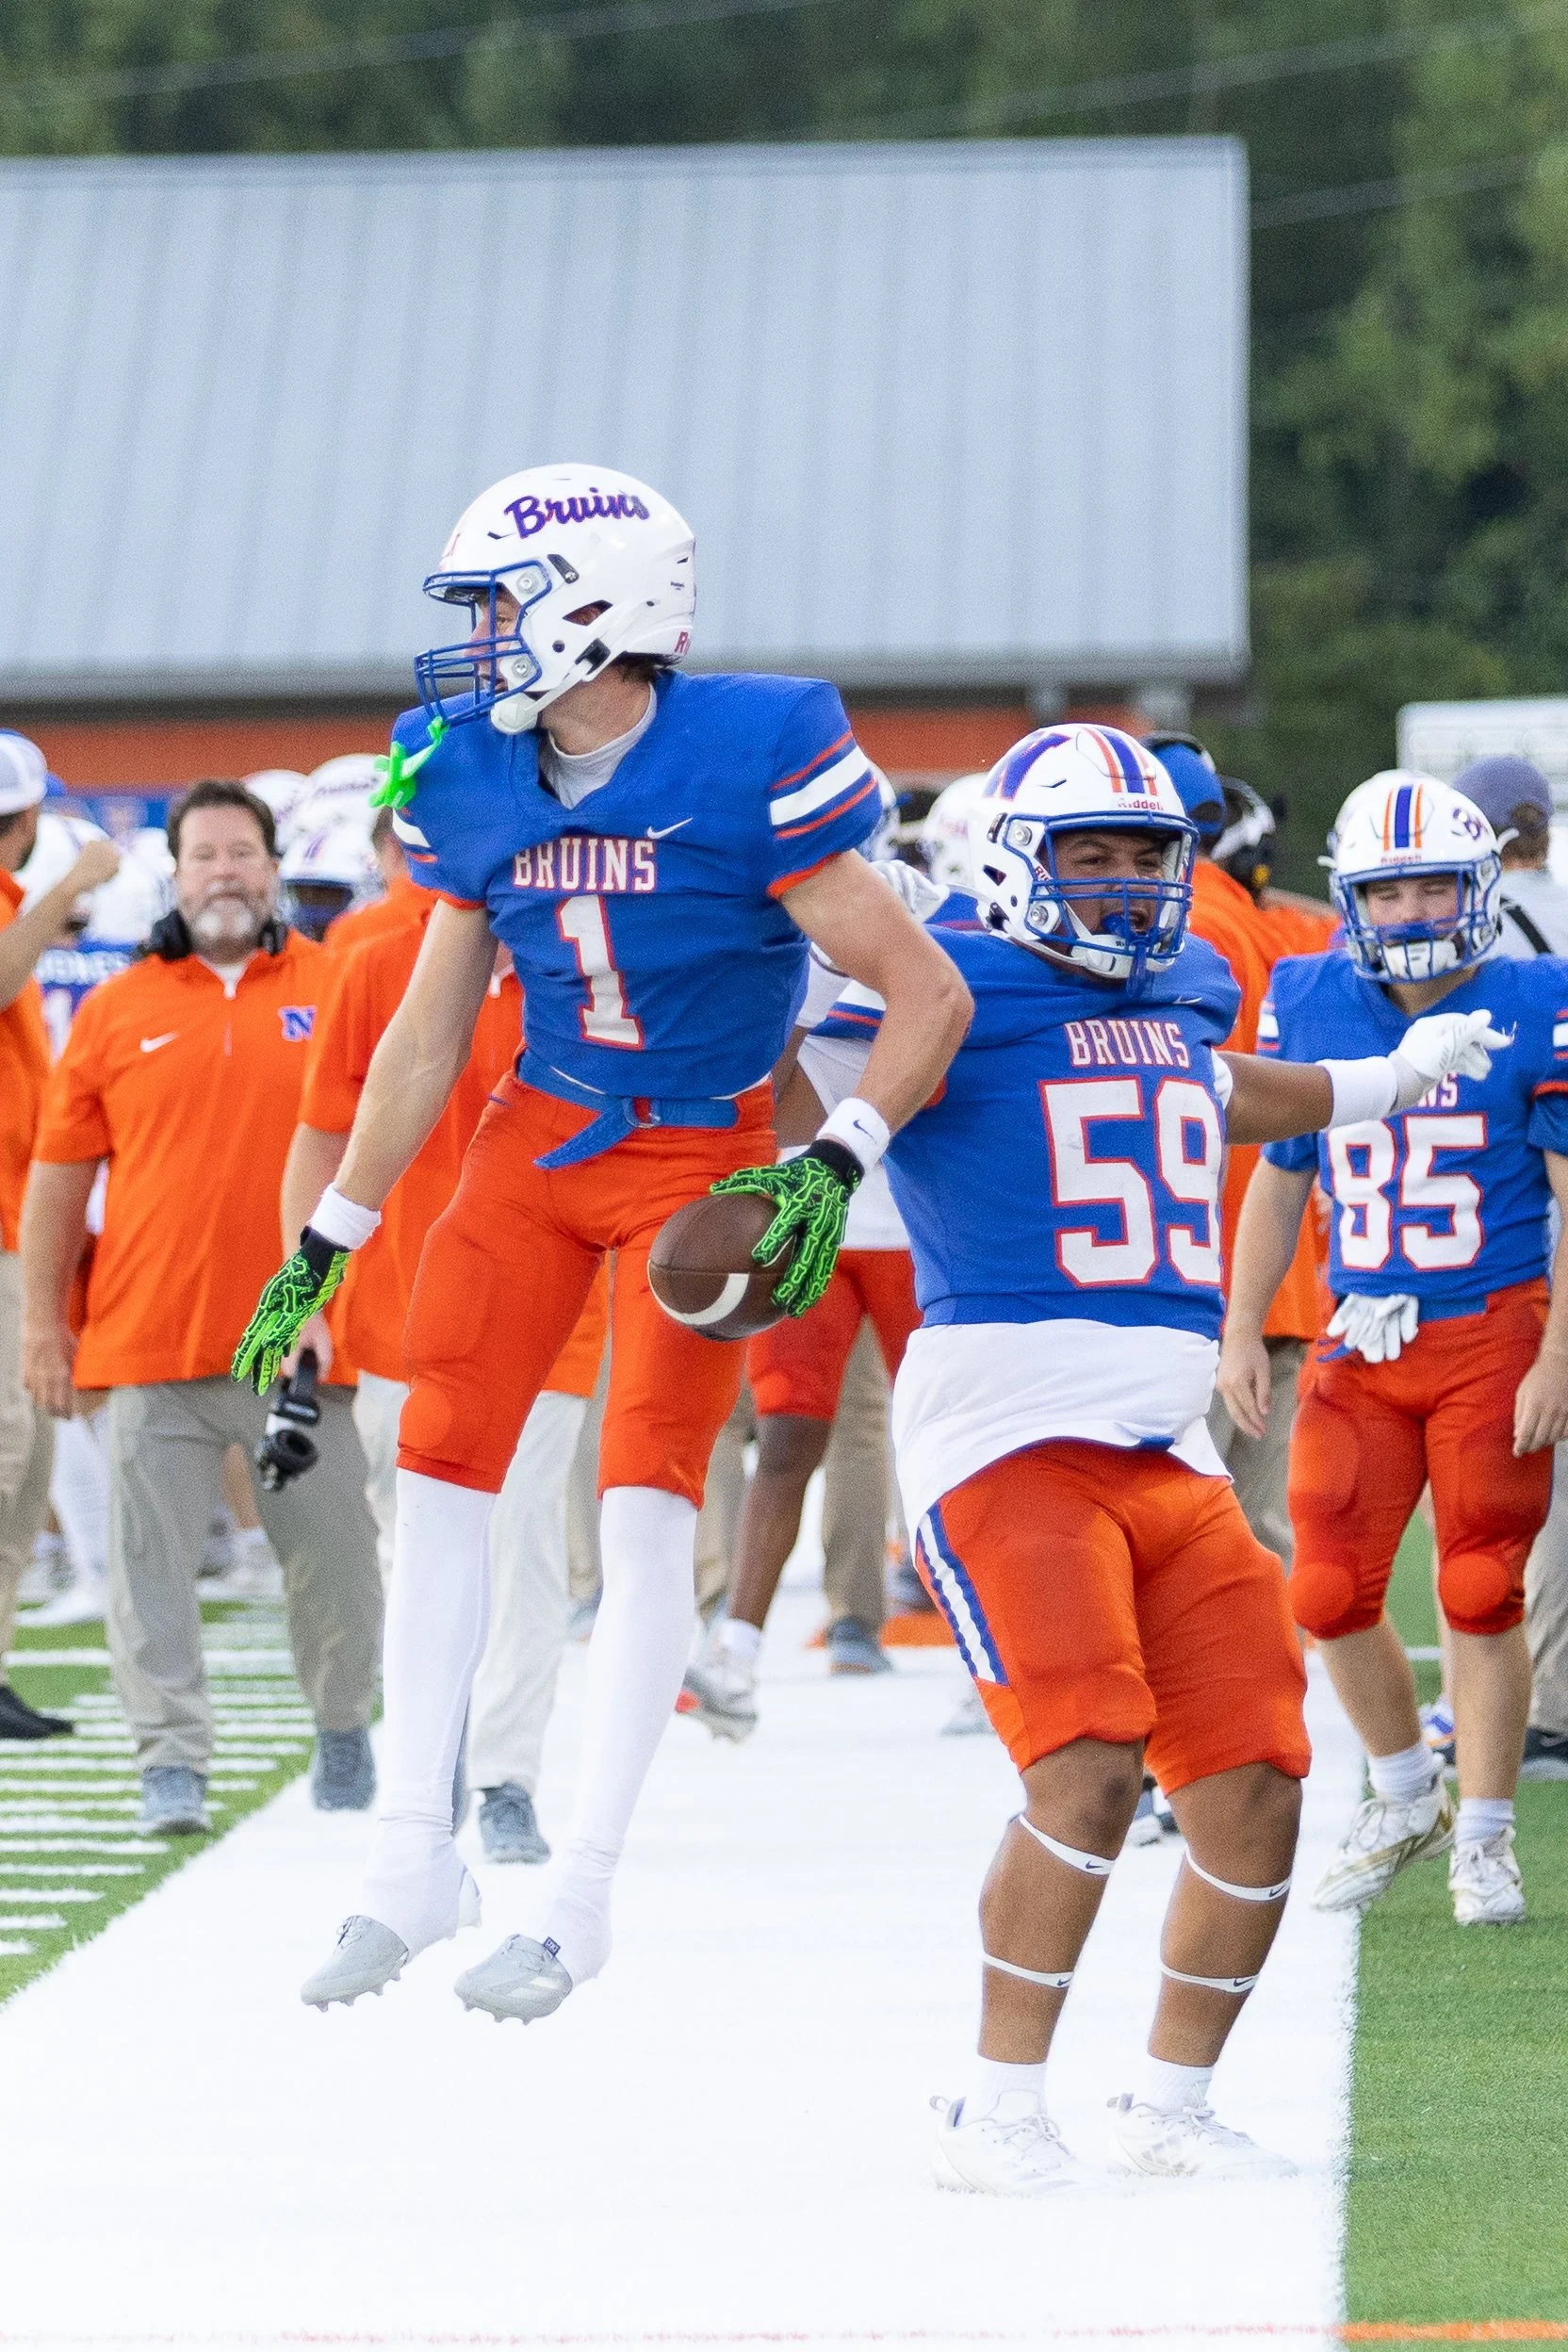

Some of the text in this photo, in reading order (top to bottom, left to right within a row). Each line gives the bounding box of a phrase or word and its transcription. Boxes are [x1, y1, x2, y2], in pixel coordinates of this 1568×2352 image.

[503, 487, 650, 538] Bruins
[513, 837, 657, 891] BRUINS
[554, 893, 645, 1052] 1
[278, 1005, 317, 1041] N
[1065, 1018, 1191, 1069] BRUINS
[1038, 1075, 1225, 1289] 59
[1327, 1111, 1488, 1271] 85
